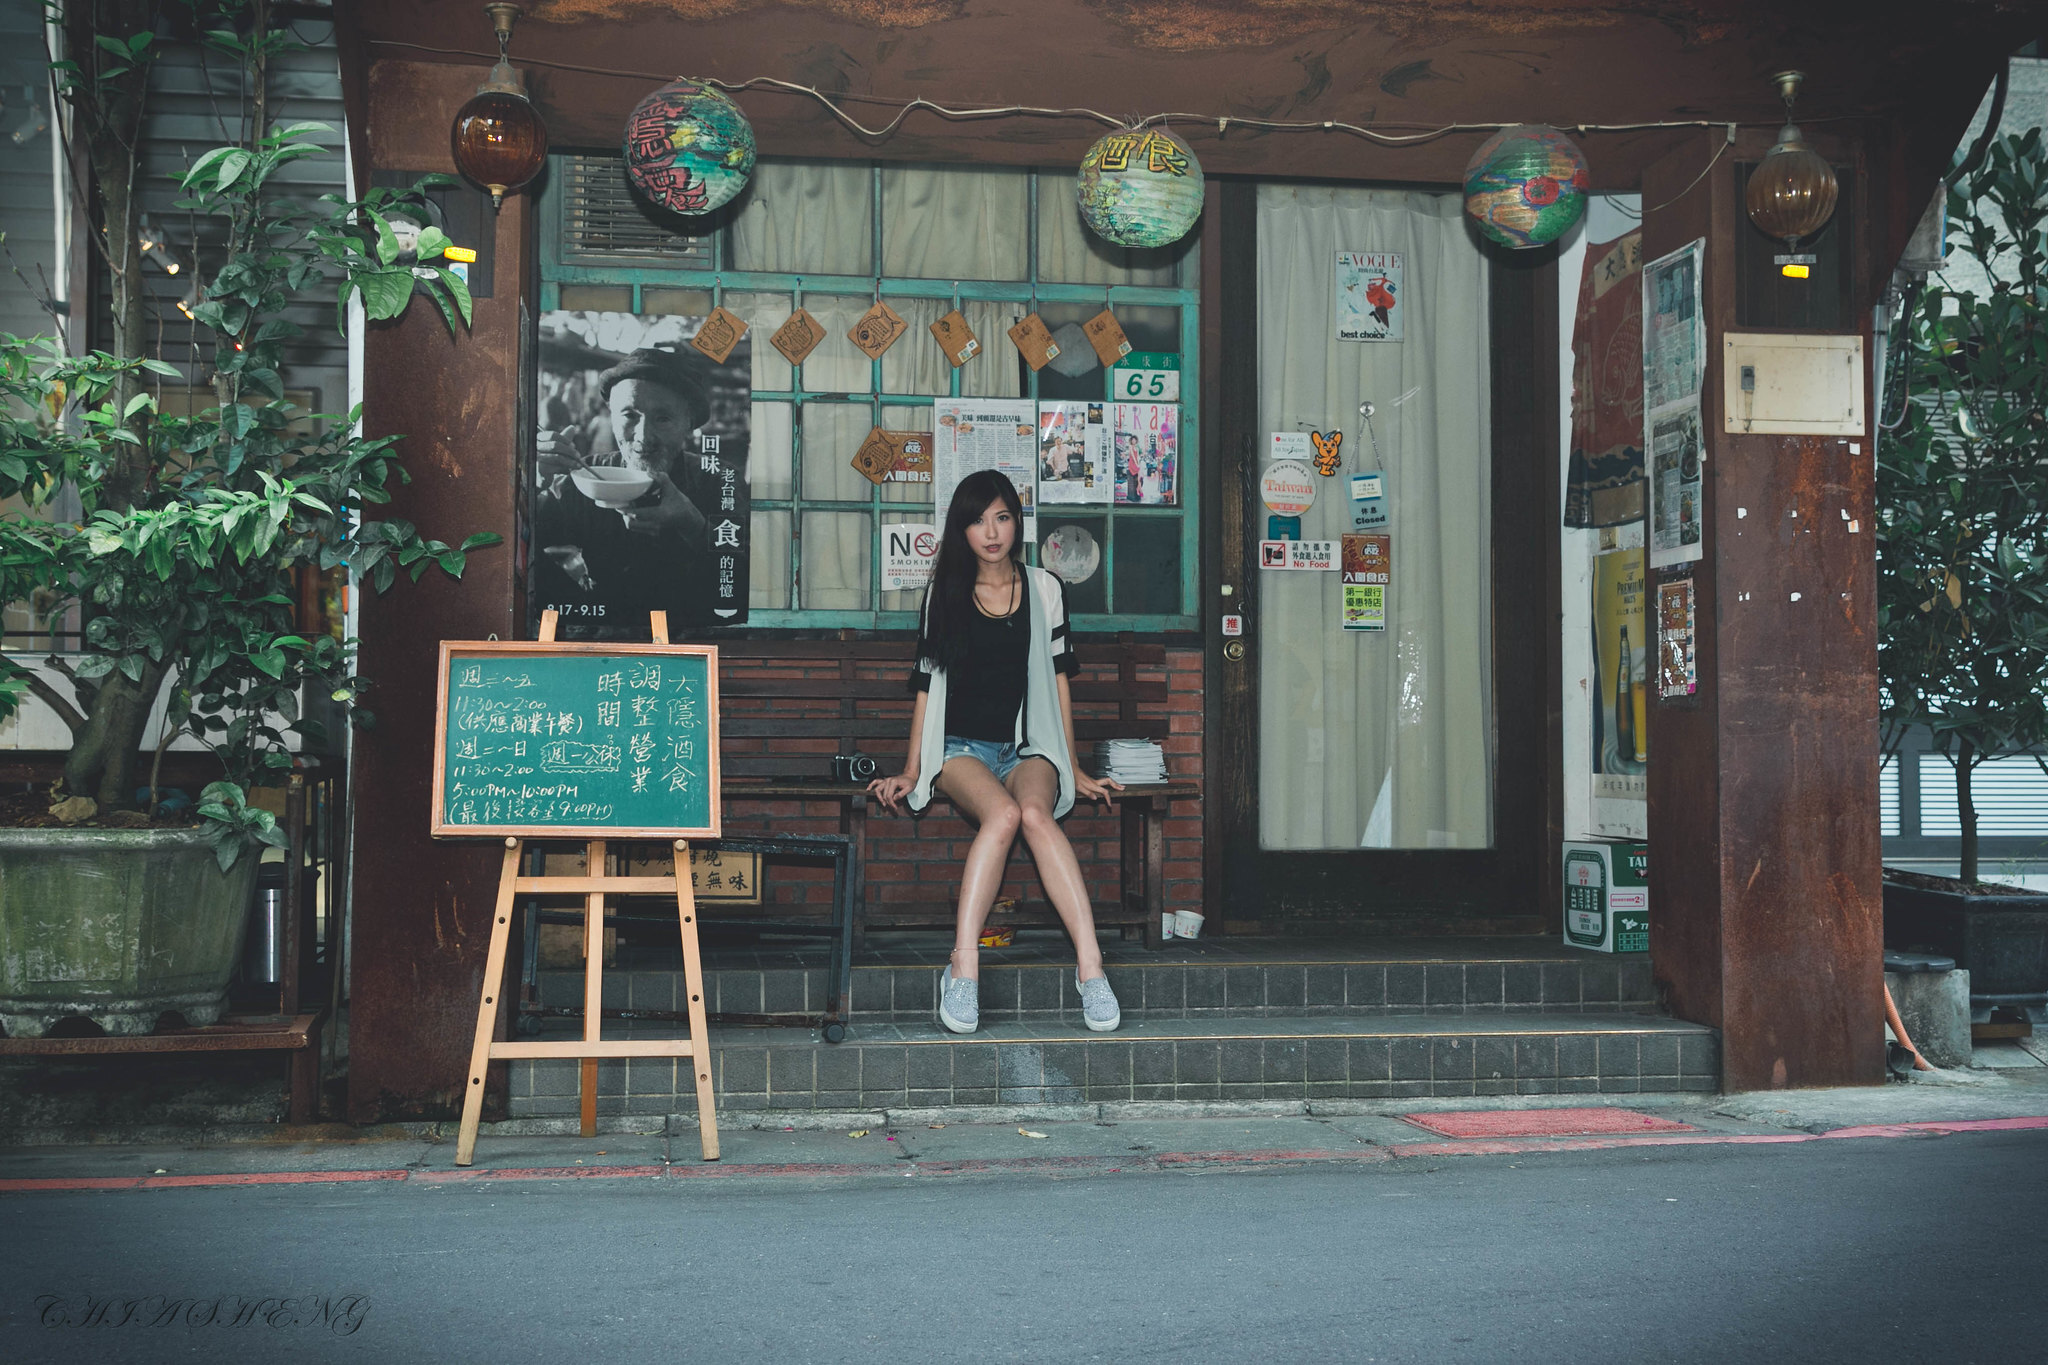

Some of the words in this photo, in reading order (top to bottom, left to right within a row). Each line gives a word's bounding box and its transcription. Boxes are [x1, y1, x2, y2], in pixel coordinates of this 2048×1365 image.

[1352, 254, 1400, 268] VOGUE
[1341, 330, 1358, 339] best
[1360, 330, 1386, 339] choice
[1126, 373, 1165, 396] 65
[701, 434, 721, 475] 回味
[721, 468, 735, 511] 老台灣
[1265, 479, 1313, 494] Taiwan
[1361, 506, 1377, 515] 休息
[1355, 515, 1386, 525] Closed
[713, 519, 741, 547] 食
[1292, 543, 1331, 552] 請勿攜帶
[1292, 552, 1331, 561] 外食進入食用
[720, 555, 734, 598] 的記憶
[1346, 587, 1382, 598] 第一銀行
[1346, 598, 1382, 608] 優惠特店
[547, 604, 606, 617] 817-9.15
[1227, 617, 1238, 629] 推
[629, 662, 661, 793] 調整營業
[660, 674, 702, 792] 大隱酒食
[548, 742, 618, 767] 週一公休
[453, 764, 534, 778] 11:30~2:00
[453, 783, 578, 800] 5:00PM~10:00PM
